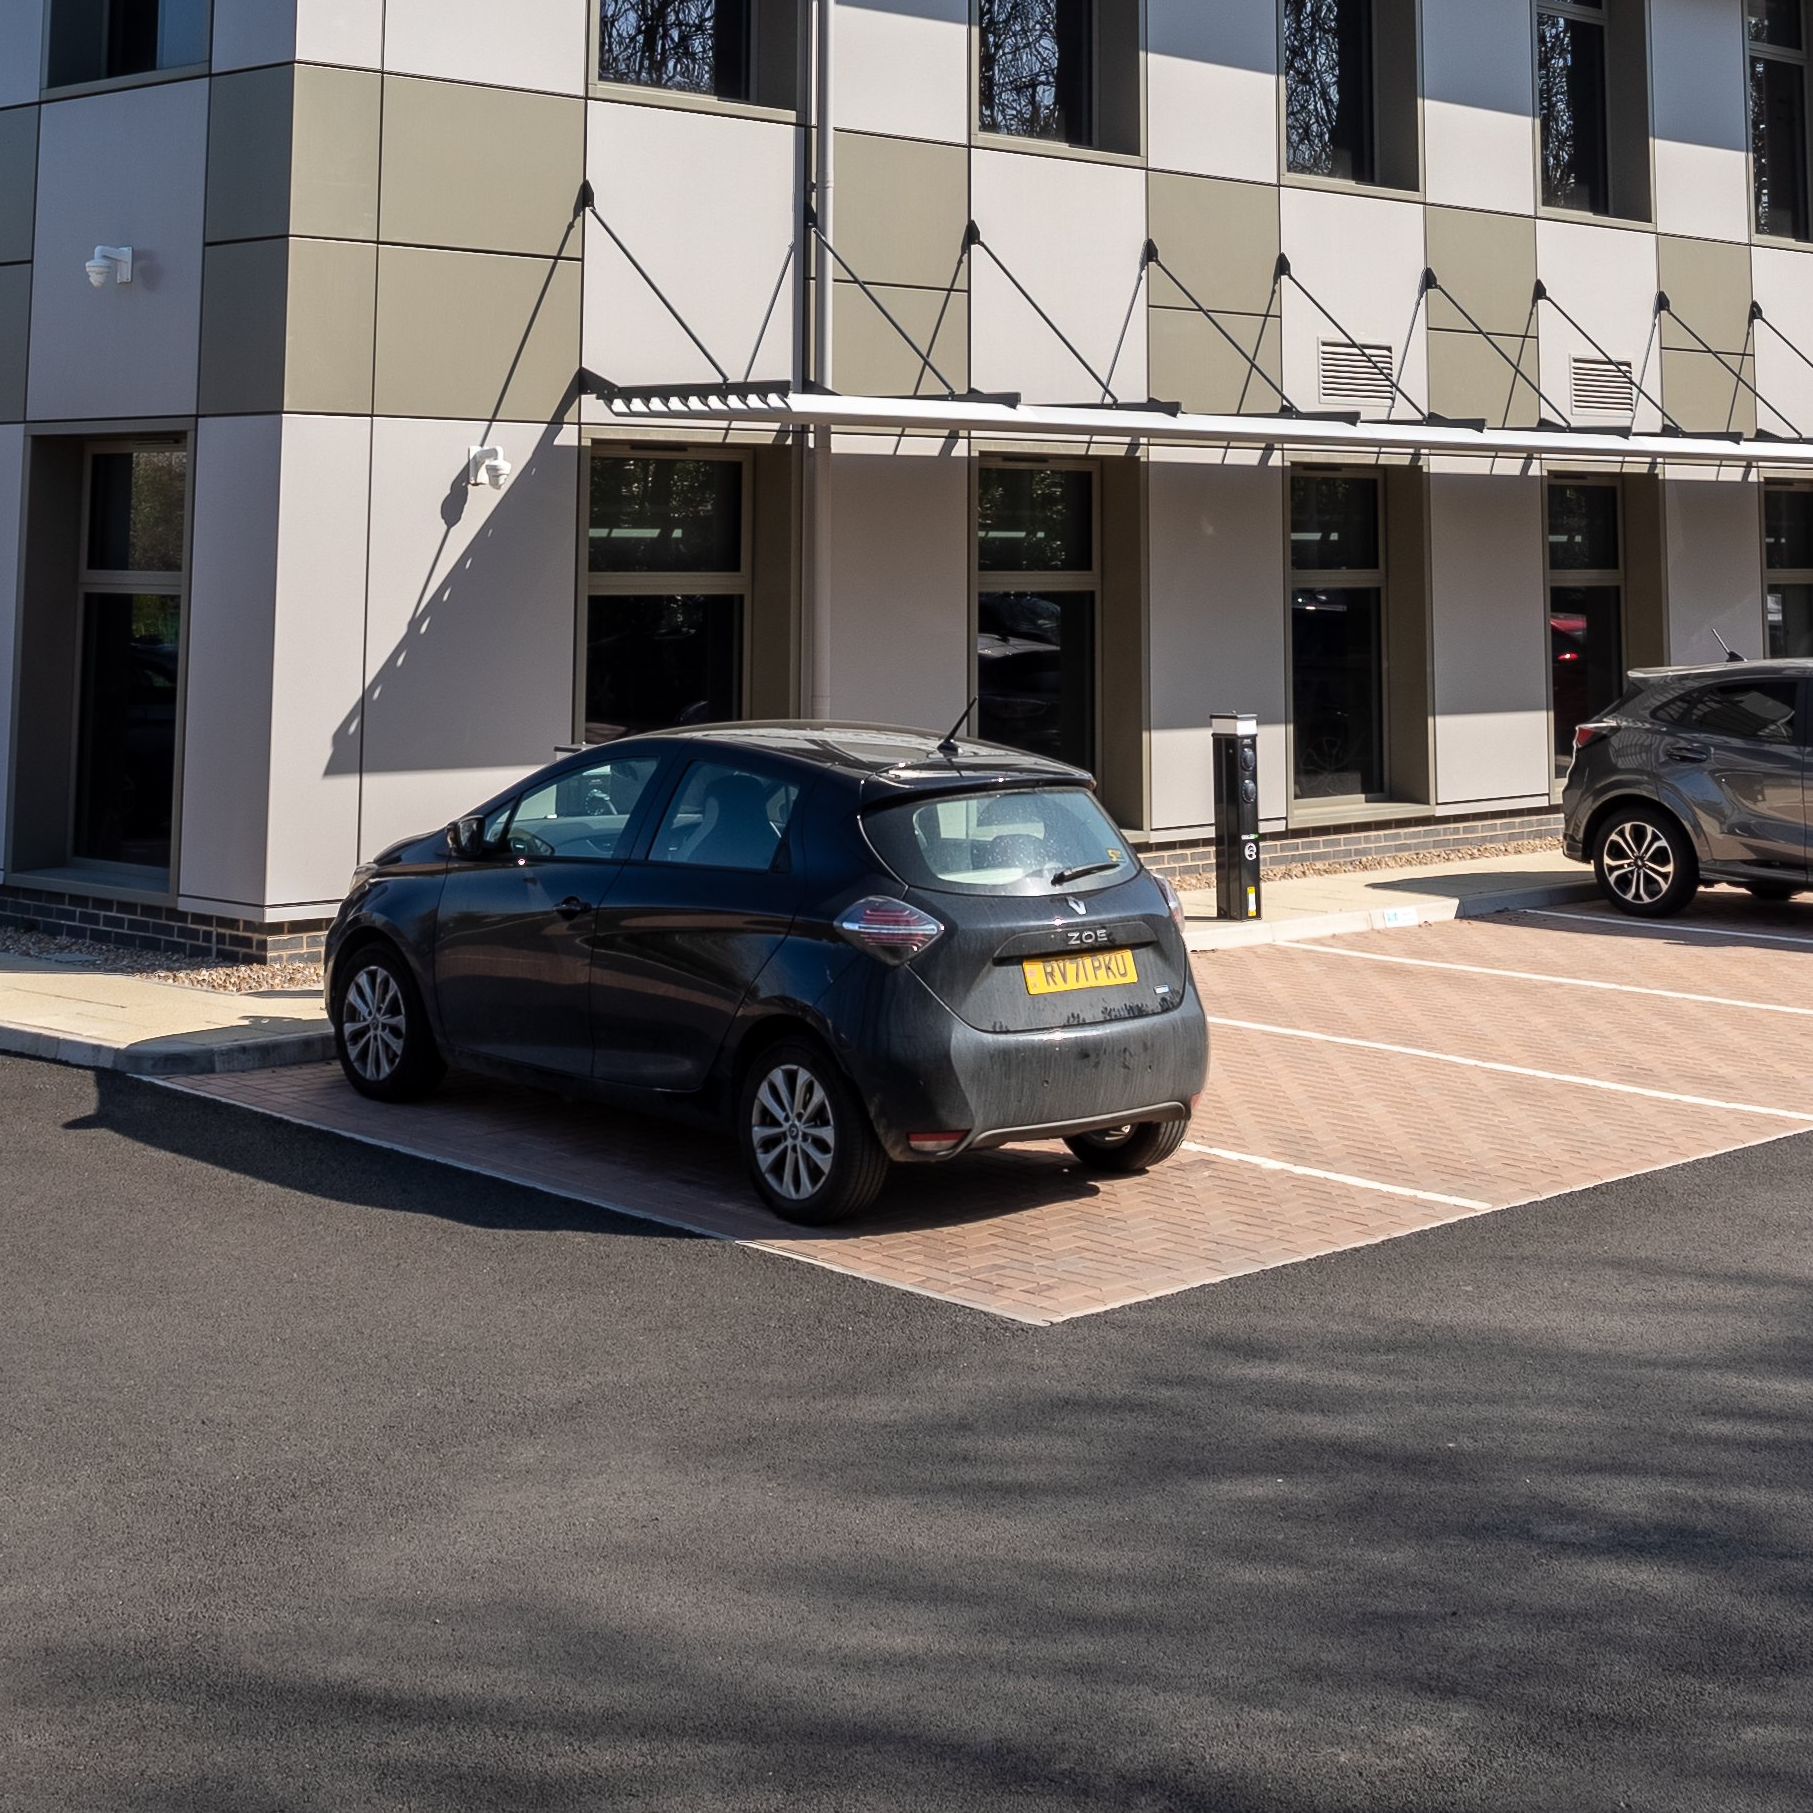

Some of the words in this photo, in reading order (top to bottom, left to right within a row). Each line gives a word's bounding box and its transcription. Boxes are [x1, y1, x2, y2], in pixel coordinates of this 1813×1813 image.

[1067, 929, 1108, 945] ZOE
[1042, 956, 1089, 987] RV71
[1090, 953, 1129, 981] PKU
